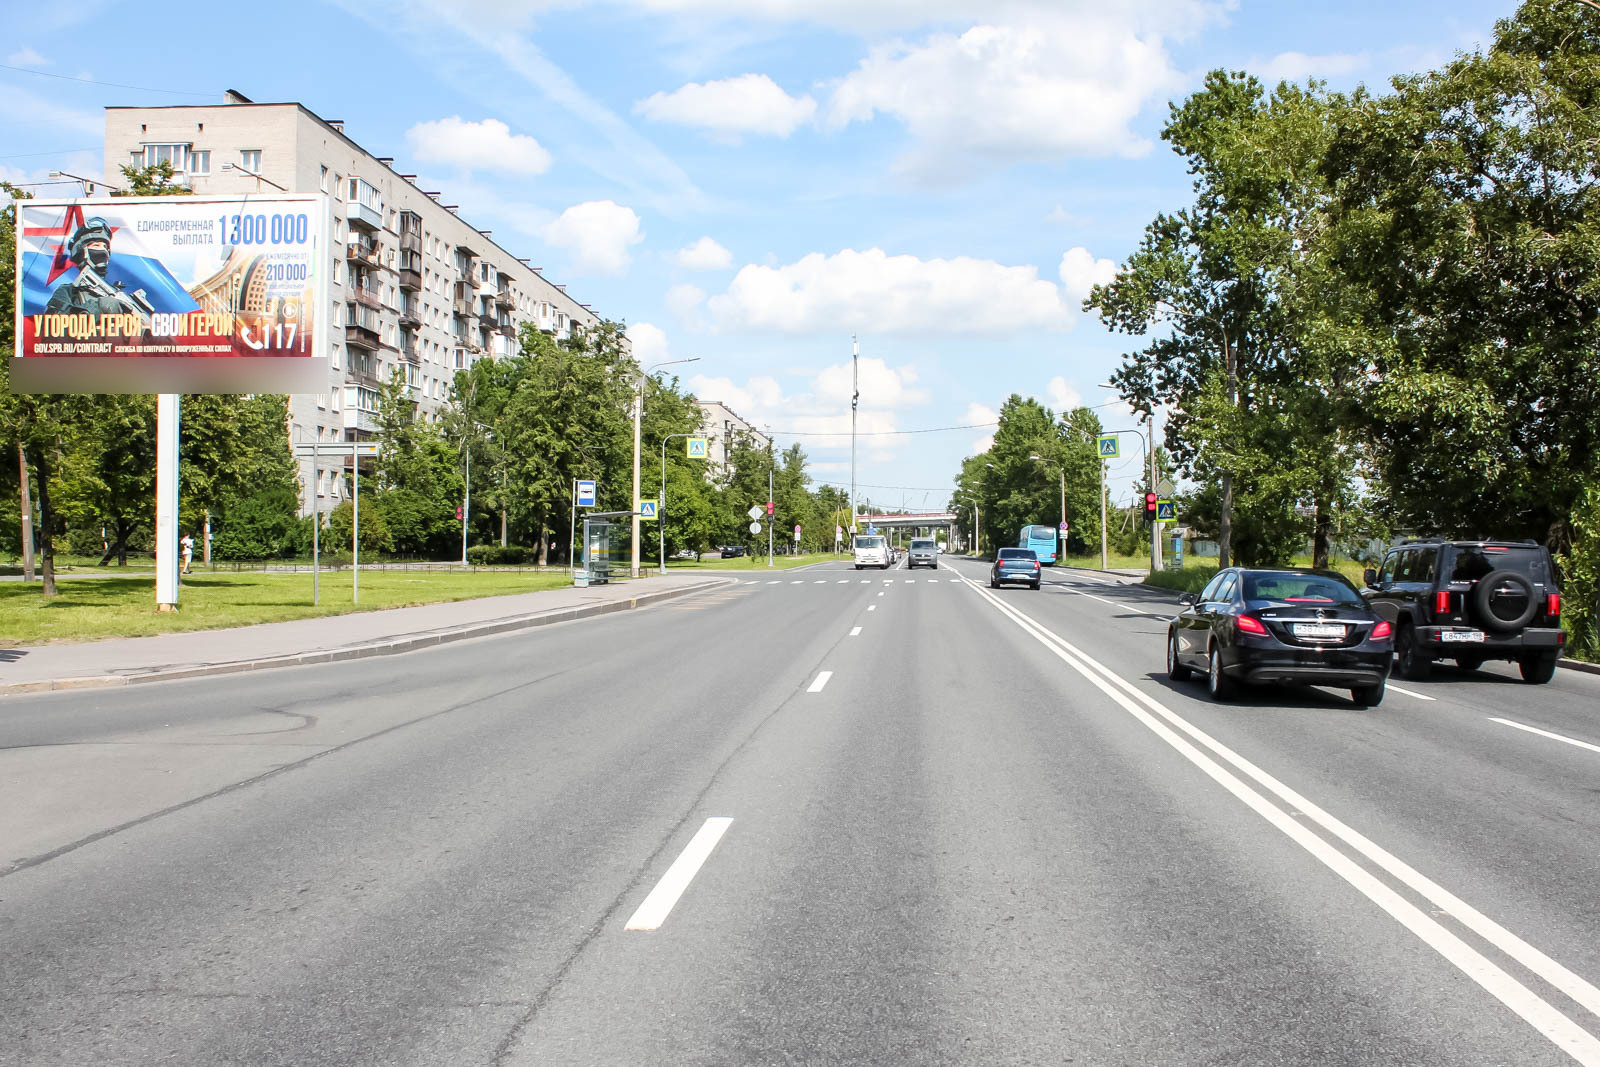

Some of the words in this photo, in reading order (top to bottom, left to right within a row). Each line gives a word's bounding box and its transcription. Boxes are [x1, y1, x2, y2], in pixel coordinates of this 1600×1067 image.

[137, 219, 214, 233] ЕДИНОВРЕМЕННАЯ
[271, 213, 308, 245] 000
[172, 233, 214, 245] ВЫПЛАТА
[265, 263, 284, 281] 210
[286, 263, 307, 281] 000
[34, 314, 43, 338] У
[44, 313, 142, 340] ГОРОДА-ГЕРОЯ
[151, 312, 188, 336] СВОИ
[190, 312, 233, 336] ГЕРОИ
[262, 323, 297, 350] 117
[34, 342, 113, 354] GOV.SPB.RU/CONTRACT
